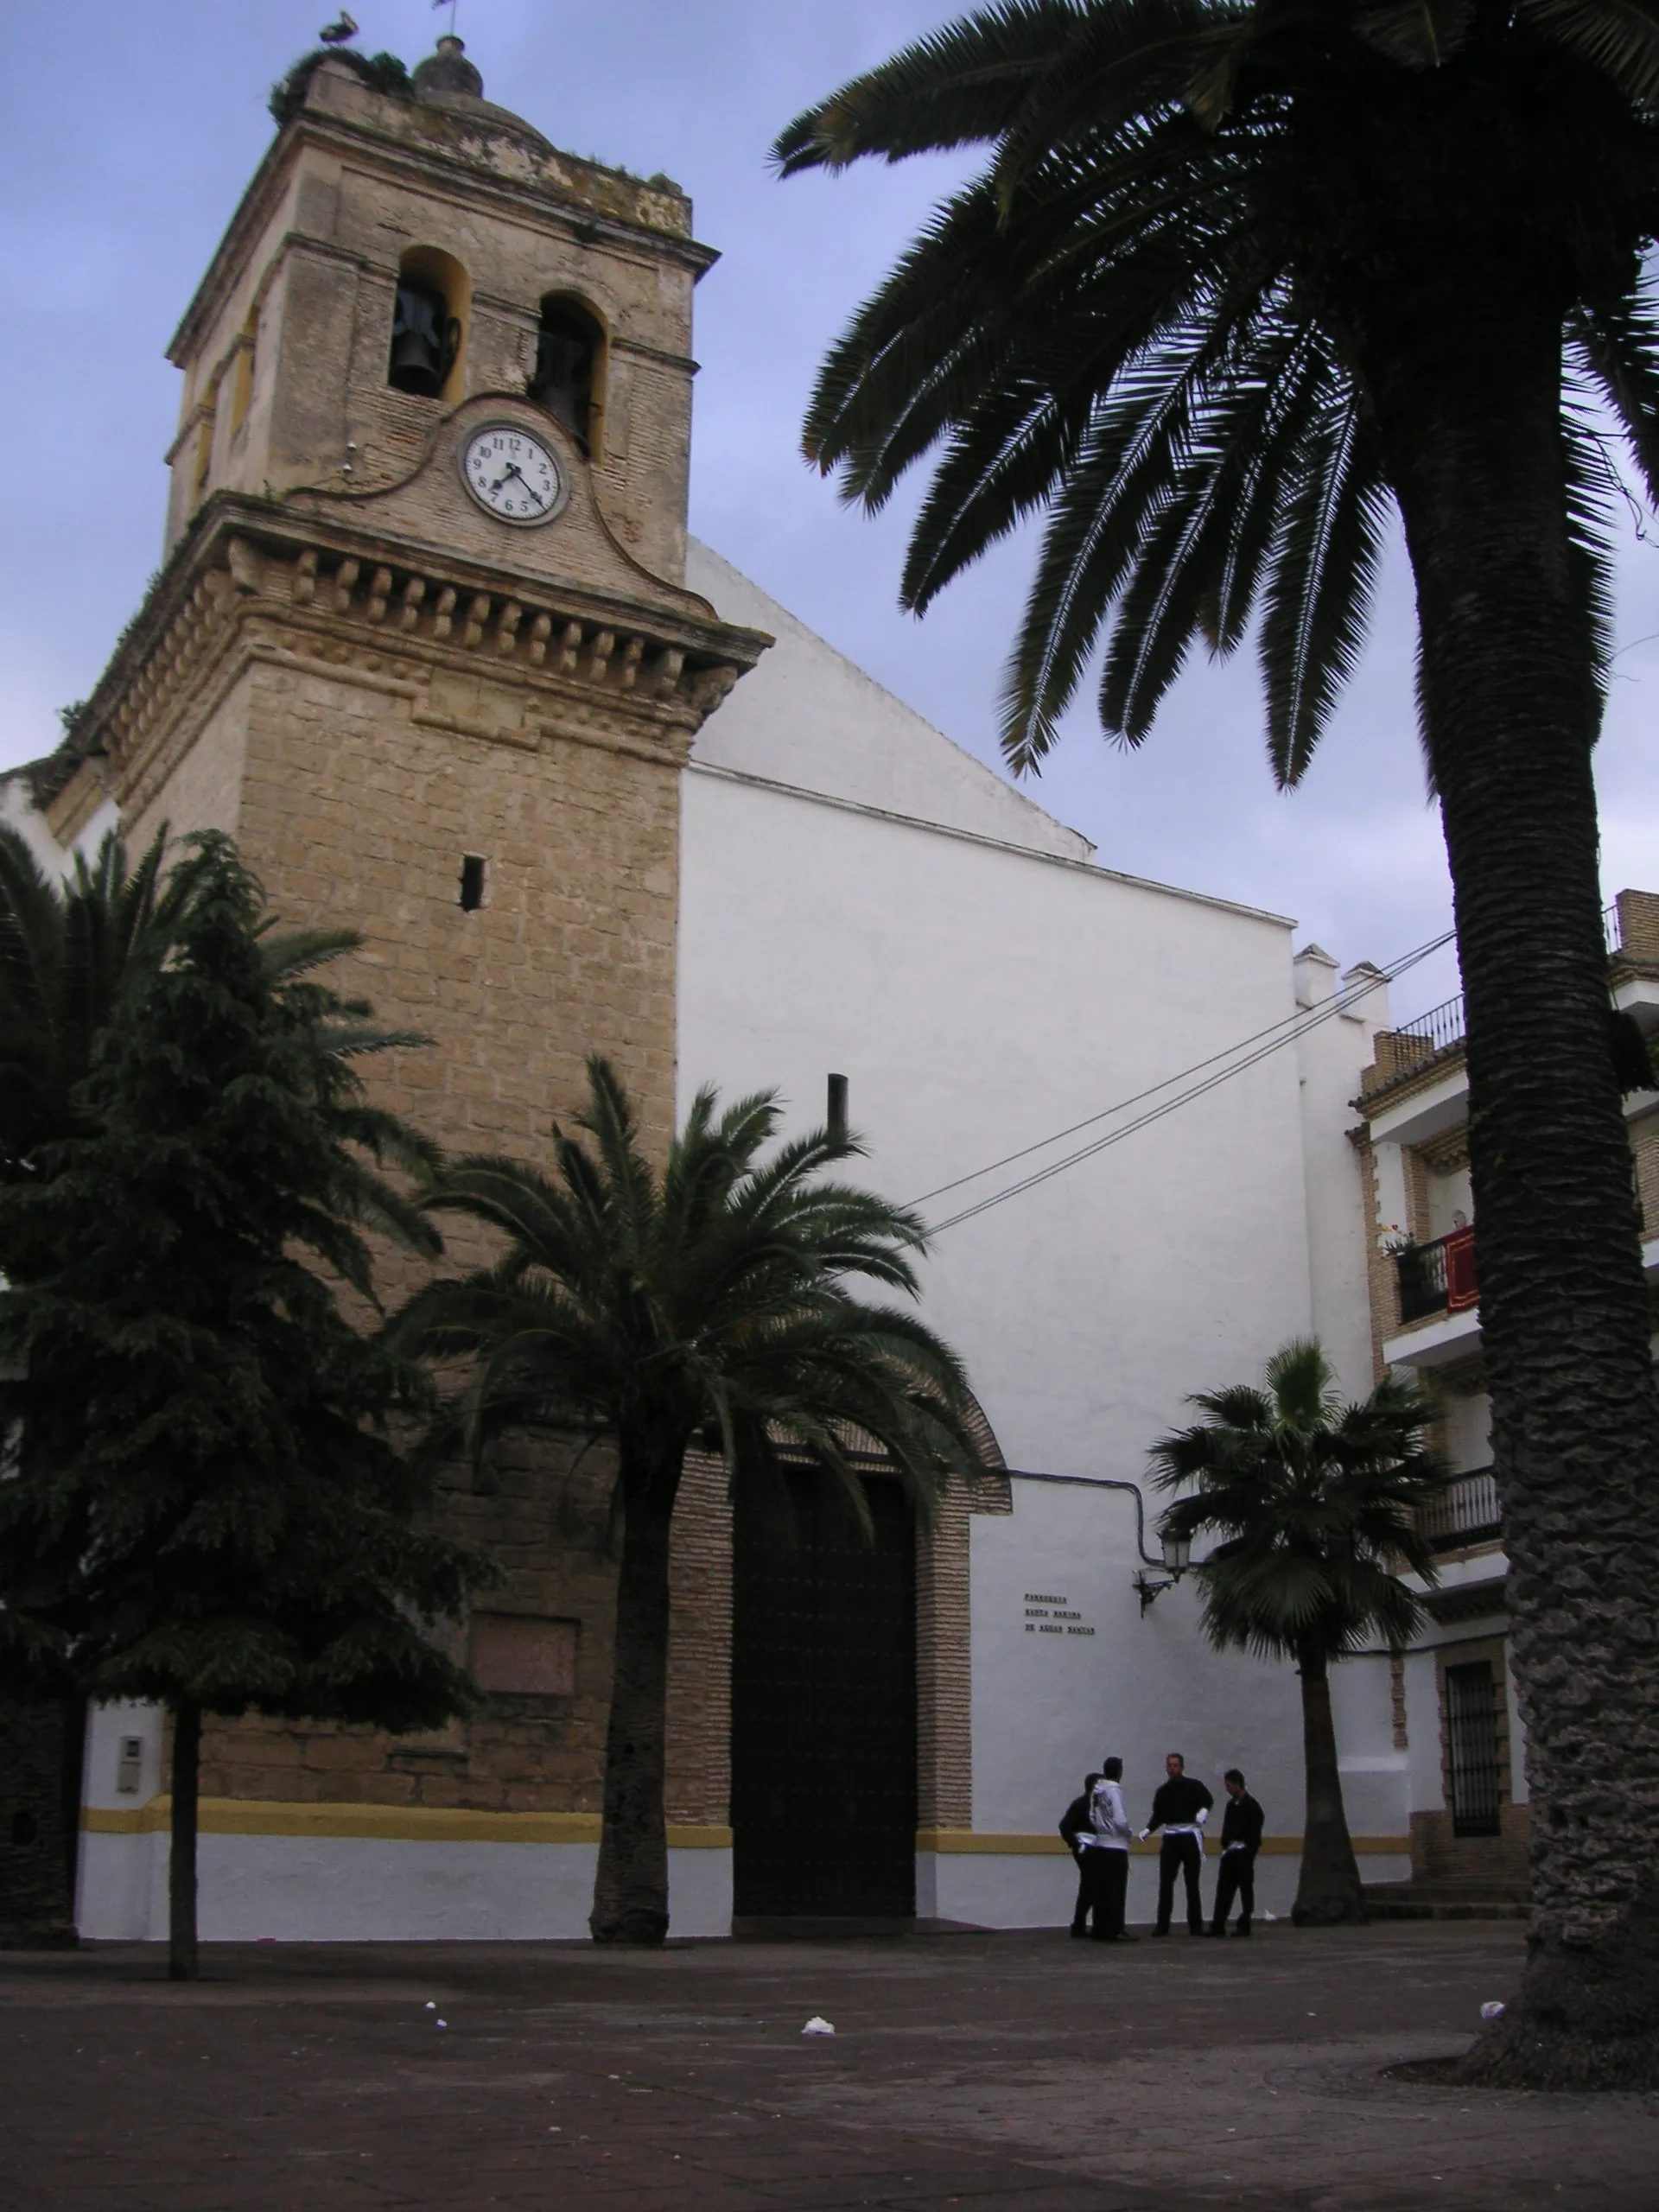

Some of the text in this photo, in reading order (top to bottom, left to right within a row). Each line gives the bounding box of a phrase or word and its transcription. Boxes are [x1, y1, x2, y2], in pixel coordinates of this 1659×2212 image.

[493, 438, 504, 450] 11
[508, 438, 521, 450] 12
[480, 446, 492, 459] 10
[528, 448, 533, 460] 1
[473, 458, 482, 470] 9
[538, 463, 547, 474] 2
[478, 476, 486, 488] 8
[543, 480, 550, 492] 3
[491, 490, 499, 502] 7
[505, 499, 513, 511] 6
[520, 500, 529, 512] 5
